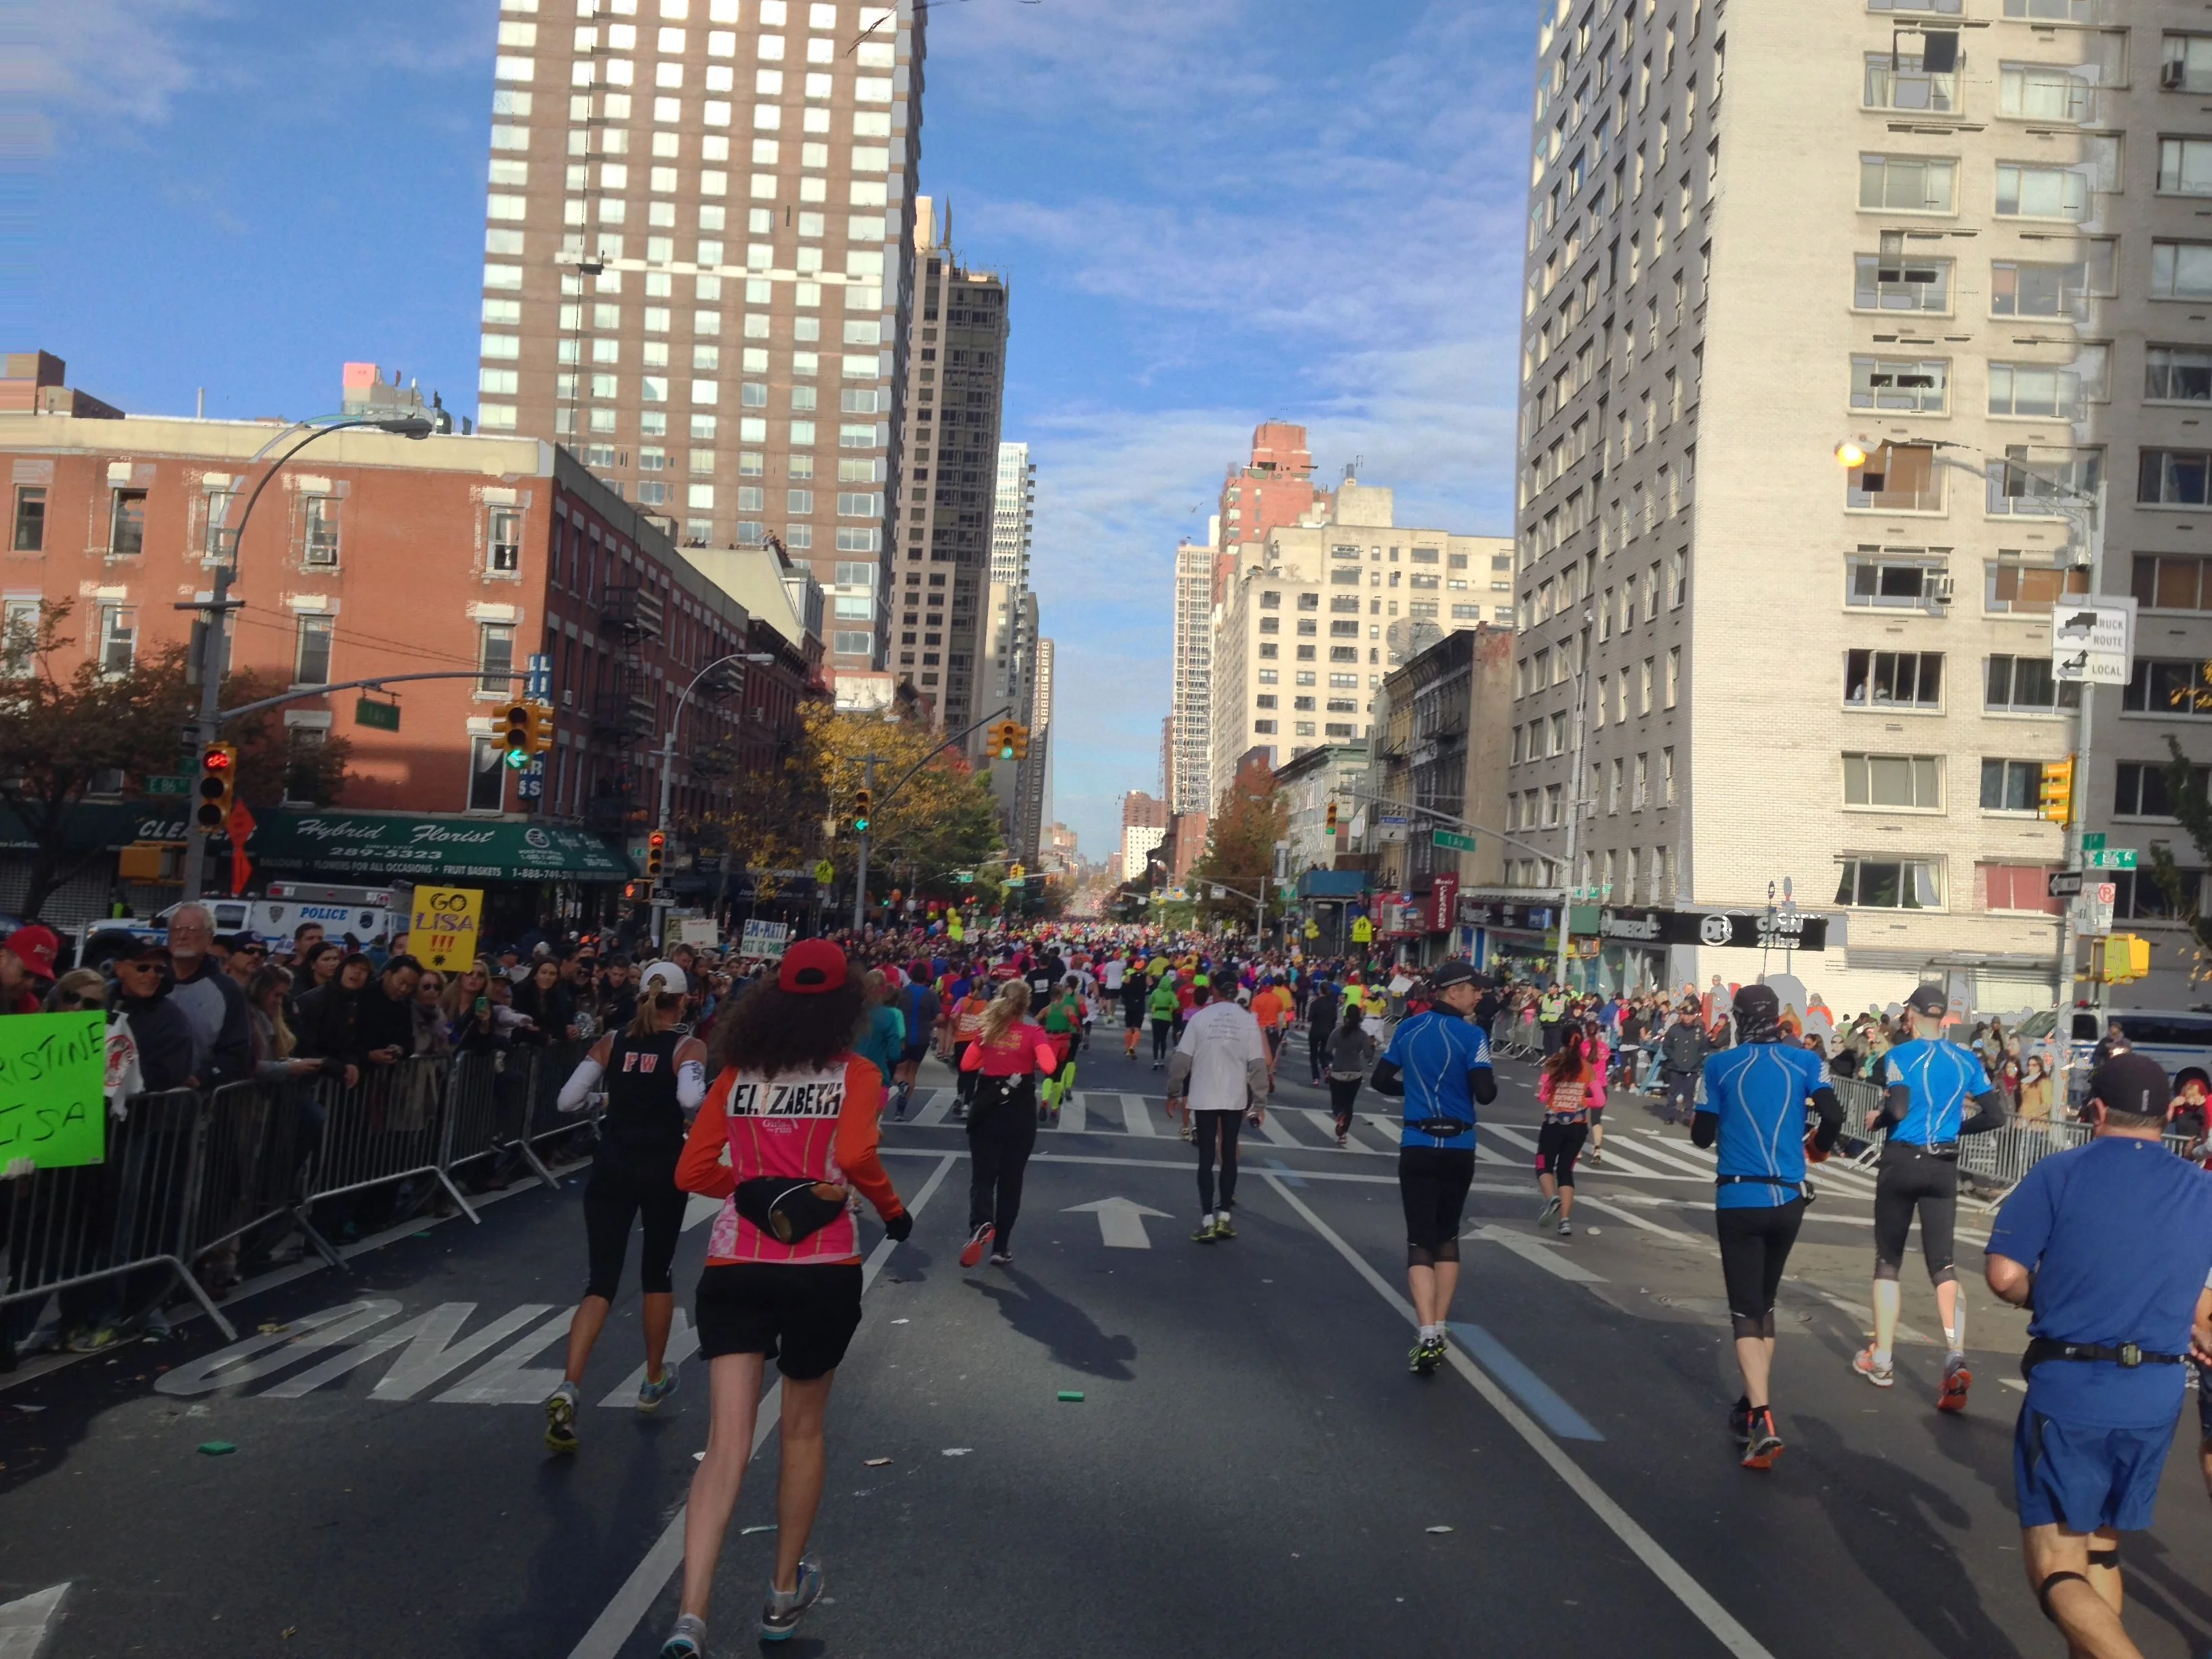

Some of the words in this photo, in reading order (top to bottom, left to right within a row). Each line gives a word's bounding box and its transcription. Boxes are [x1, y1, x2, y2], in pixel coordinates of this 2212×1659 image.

[2093, 635, 2124, 647] ROUTE
[2091, 665, 2123, 677] LOCAL
[297, 819, 386, 839] Hybrid
[409, 825, 496, 844] Florist
[328, 847, 443, 859] 289-5323
[352, 861, 368, 872] FOR
[369, 862, 384, 872] ALL
[386, 863, 434, 874] OCCASIONS
[443, 865, 466, 876] FRUIT
[467, 866, 502, 877] BASKETS
[430, 893, 467, 912] GO
[300, 907, 349, 920] POLICE
[415, 912, 474, 932] LISA
[734, 1082, 842, 1115] ELZABETH
